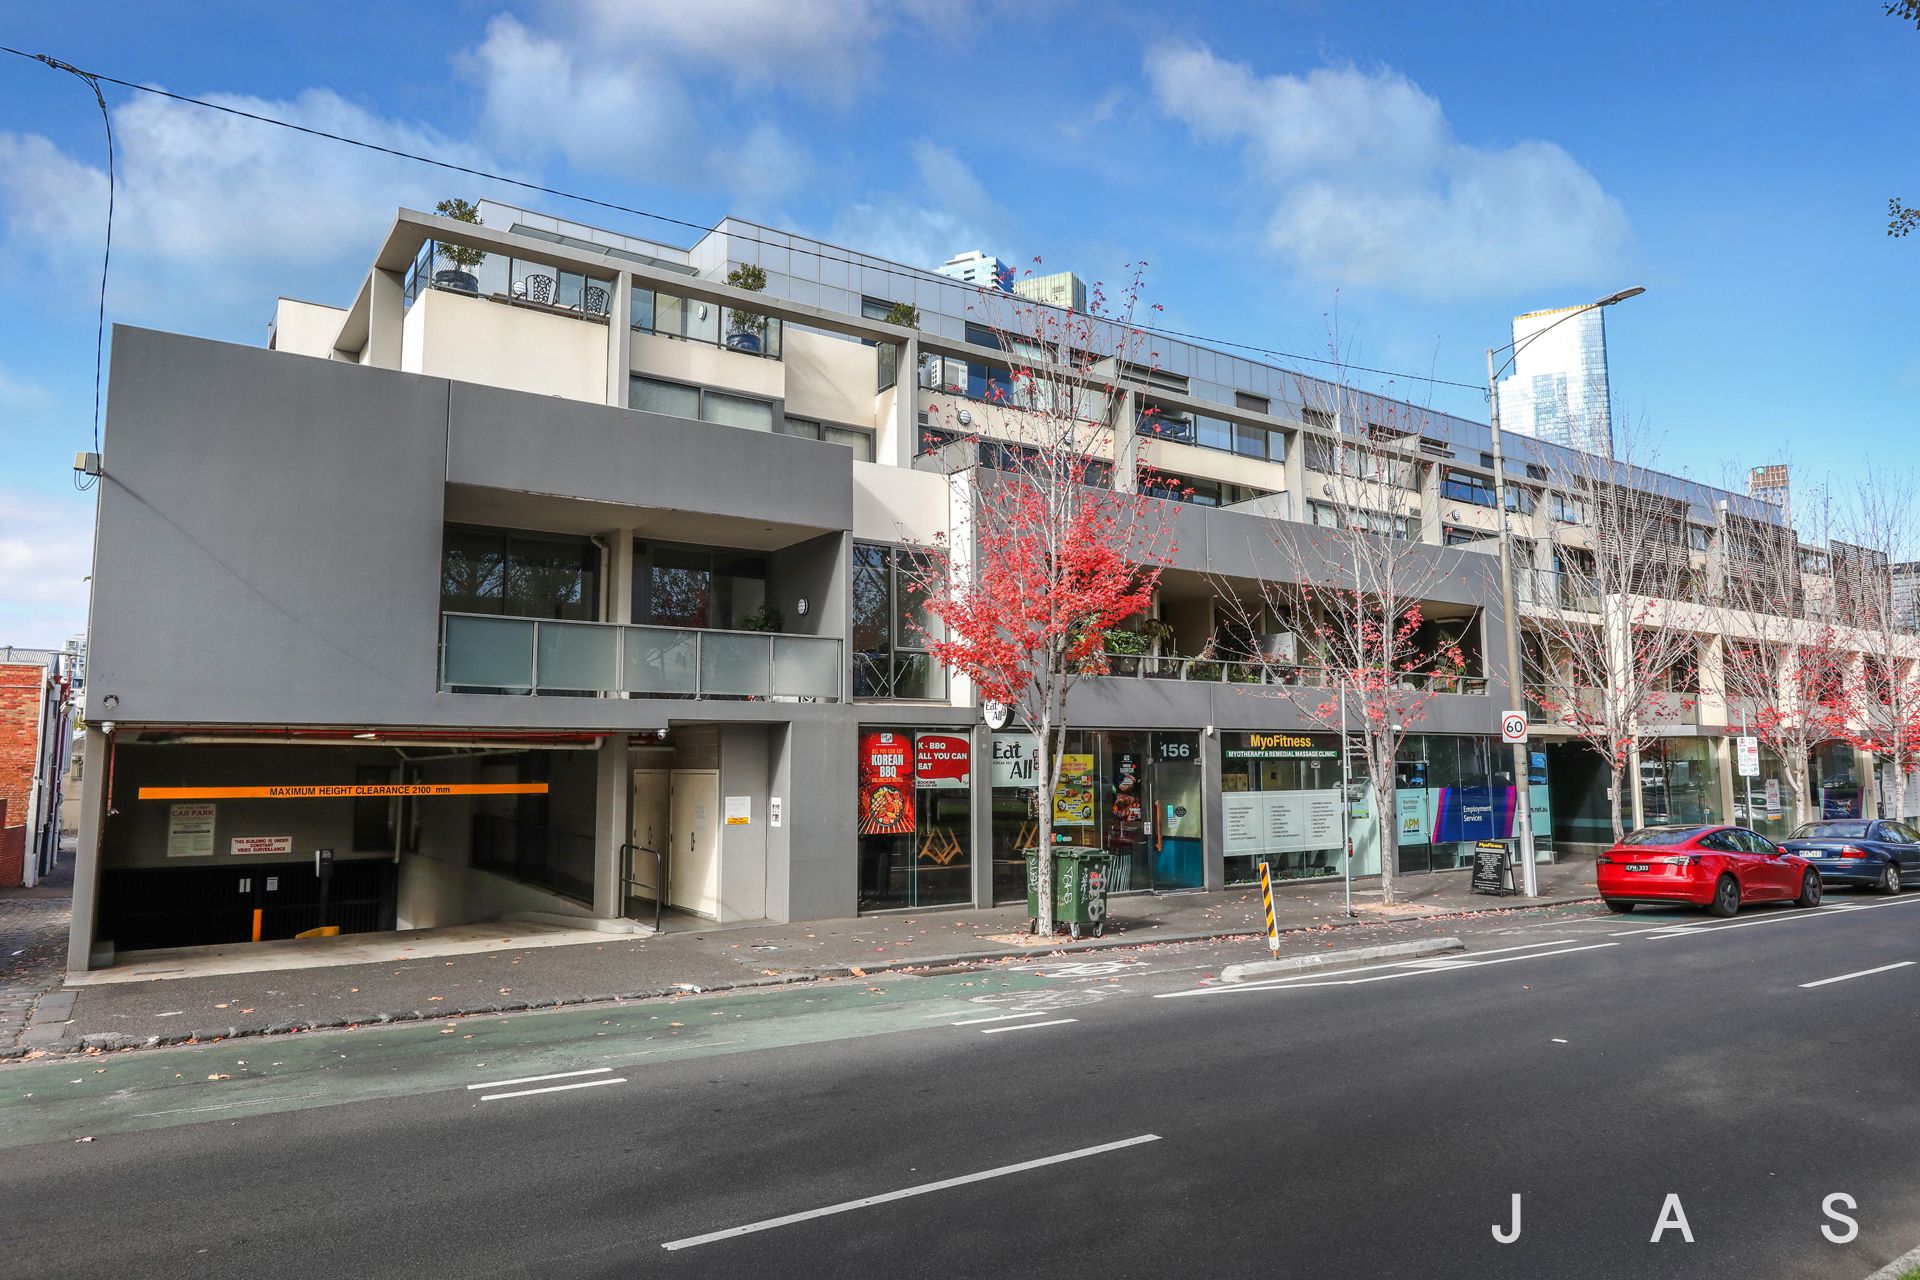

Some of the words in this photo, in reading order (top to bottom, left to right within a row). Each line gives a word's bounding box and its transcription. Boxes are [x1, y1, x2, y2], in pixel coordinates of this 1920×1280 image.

[992, 711, 1002, 720] All
[1506, 721, 1523, 733] 60
[992, 741, 1022, 759] Eat
[1161, 744, 1190, 757] 156
[871, 754, 904, 766] KOREAN
[880, 766, 897, 778] BBQ
[1009, 759, 1032, 779] All
[269, 787, 316, 796] MAXIMUM
[319, 787, 352, 795] HEIGHT
[355, 786, 409, 794] CLEARANCE
[412, 786, 431, 794] 2100
[1463, 805, 1492, 813] Employment
[1404, 818, 1419, 829] APM
